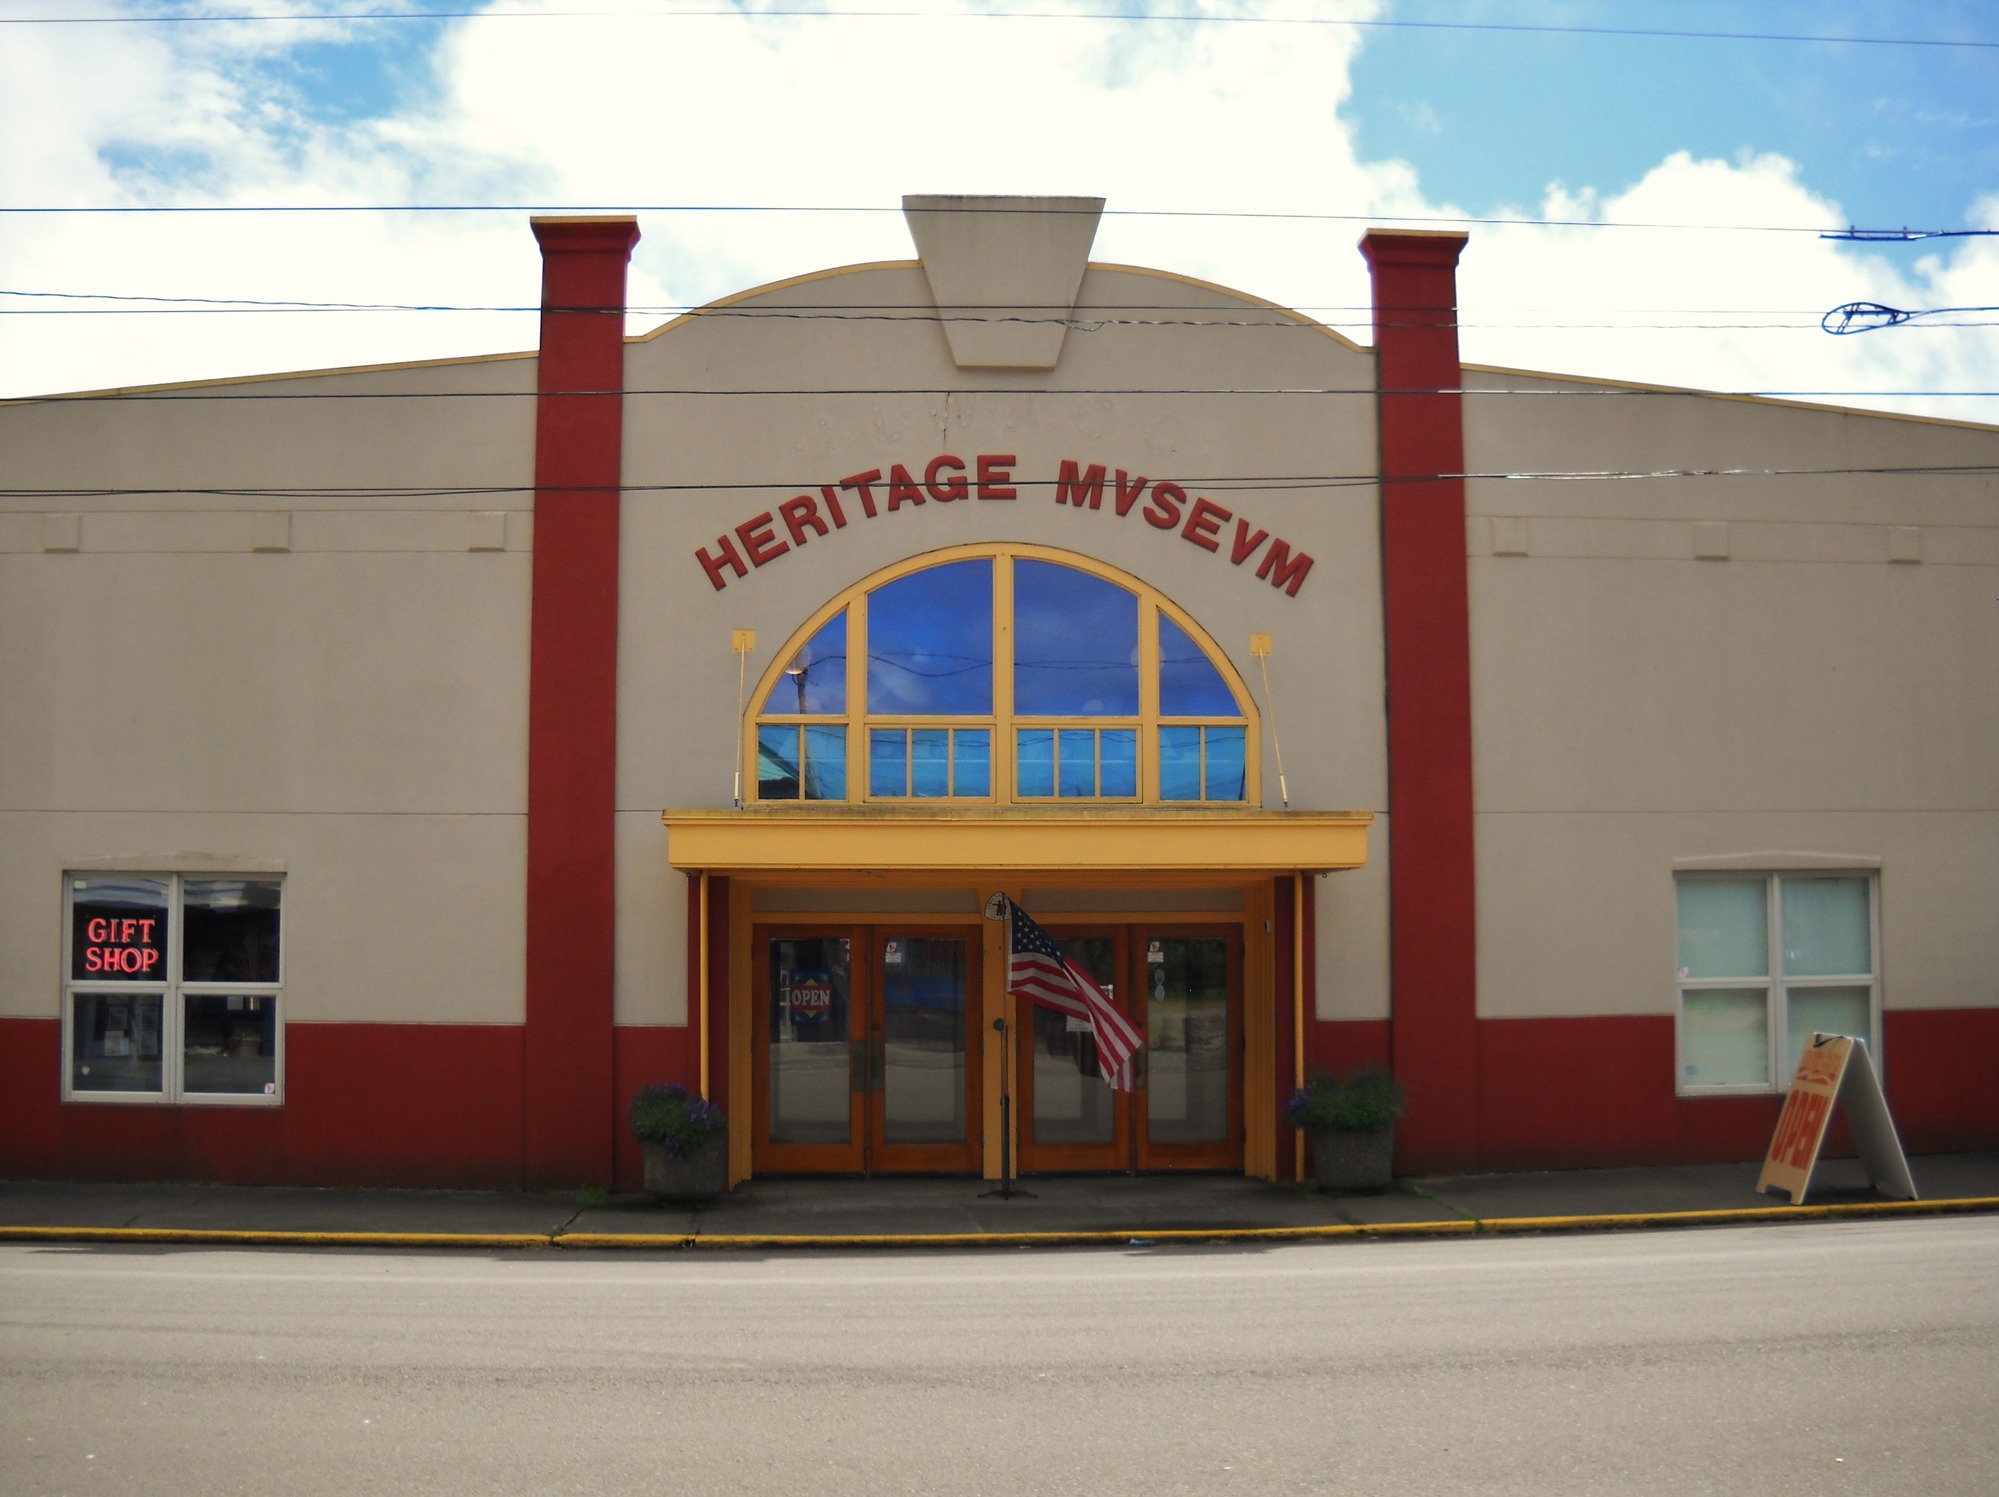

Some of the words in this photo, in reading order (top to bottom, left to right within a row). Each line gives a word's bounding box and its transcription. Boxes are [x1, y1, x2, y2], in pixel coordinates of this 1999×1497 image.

[695, 455, 1016, 591] HERITAGE
[88, 918, 155, 943] GIFT
[86, 947, 158, 973] SHOP
[792, 990, 830, 1006] OPEN
[1771, 1089, 1829, 1170] OPEN
